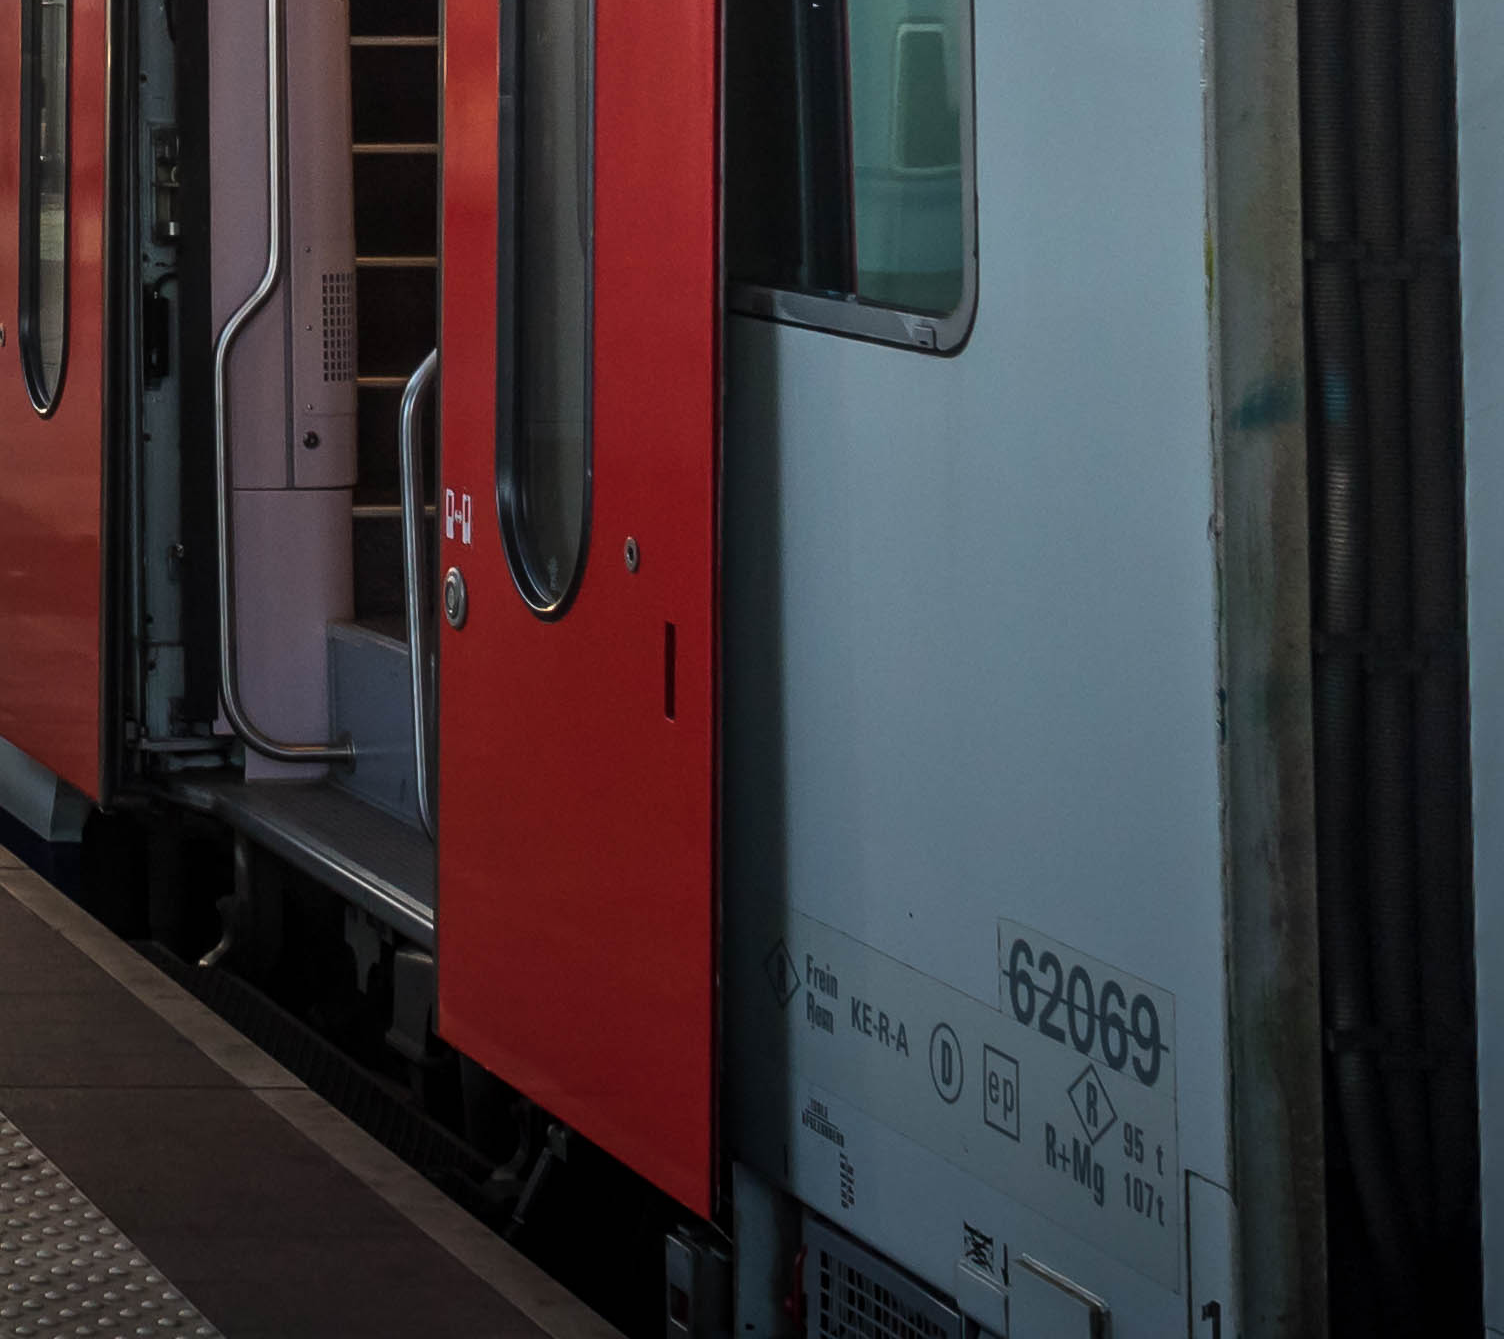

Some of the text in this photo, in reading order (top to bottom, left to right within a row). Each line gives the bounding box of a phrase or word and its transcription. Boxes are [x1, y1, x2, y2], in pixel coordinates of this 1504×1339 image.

[806, 953, 838, 1000] Frein
[851, 996, 910, 1058] KE-R-A
[1009, 938, 1161, 1087] 62069
[941, 1039, 953, 1086] D
[988, 1070, 1015, 1122] ep
[1086, 1080, 1098, 1129] R
[1045, 1122, 1105, 1208] R+Mg
[1123, 1122, 1145, 1164] 95
